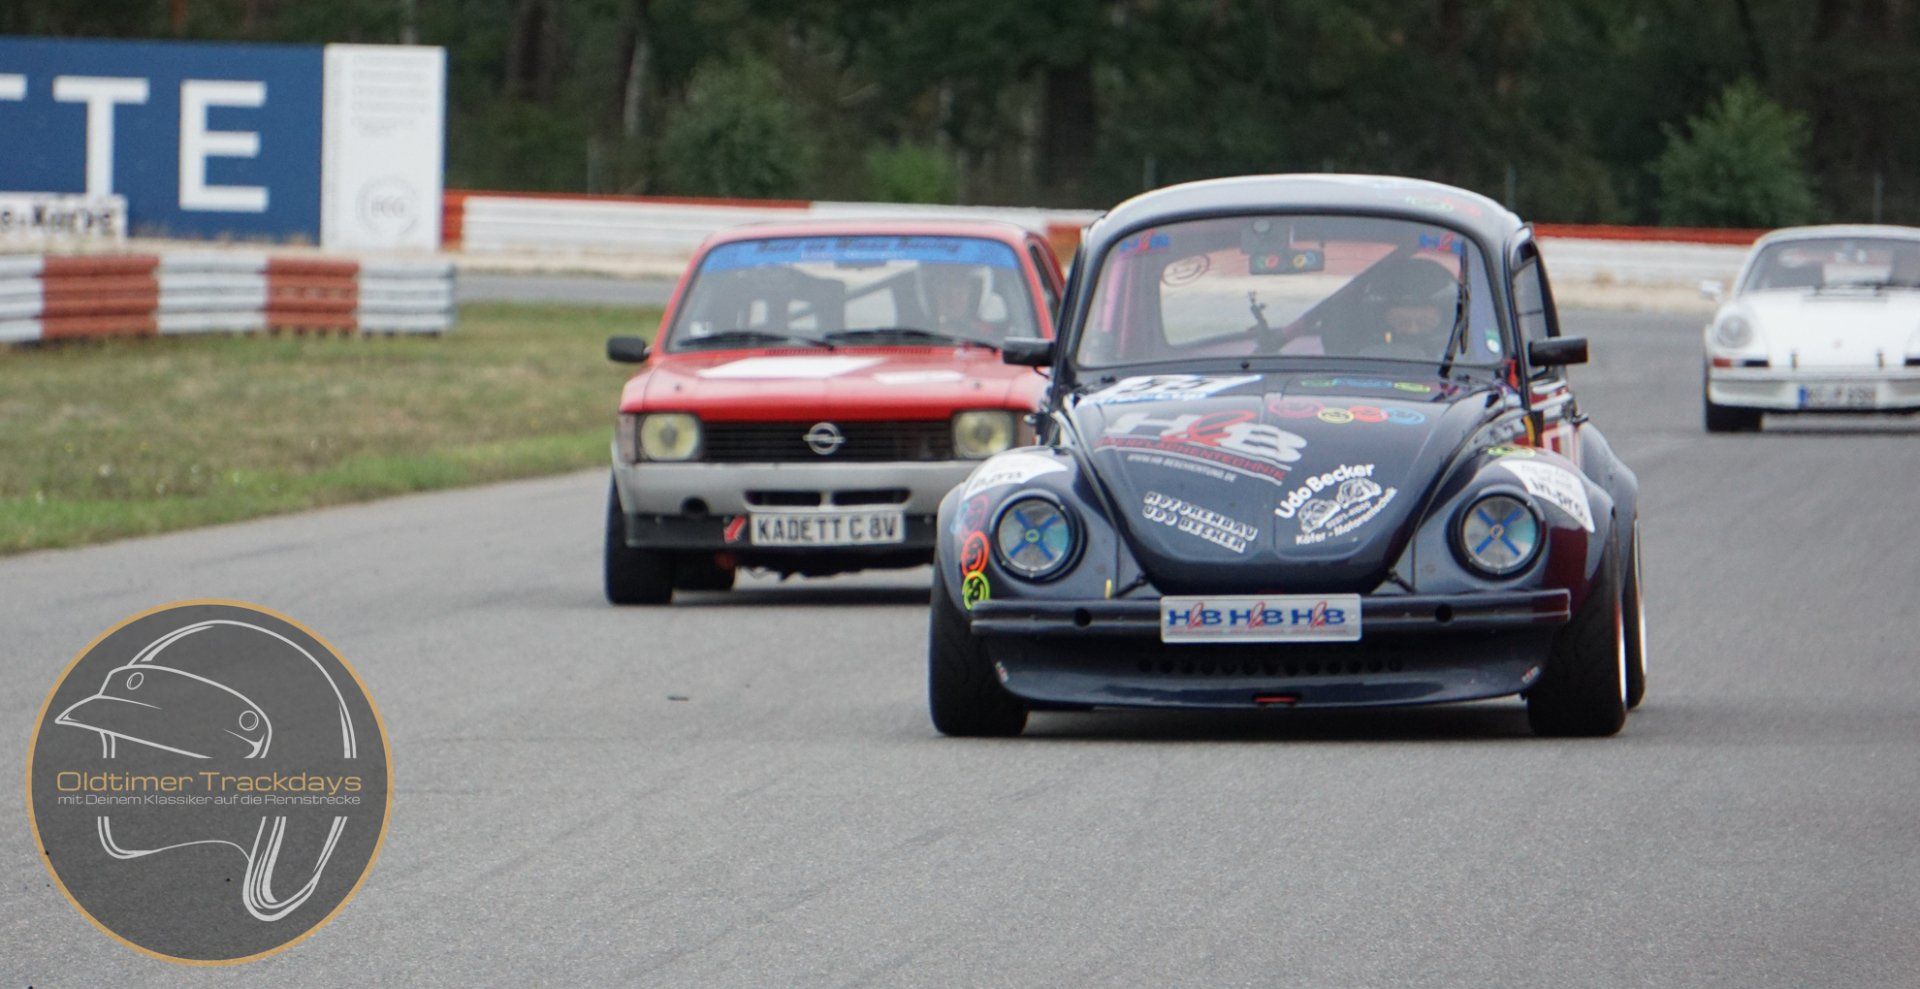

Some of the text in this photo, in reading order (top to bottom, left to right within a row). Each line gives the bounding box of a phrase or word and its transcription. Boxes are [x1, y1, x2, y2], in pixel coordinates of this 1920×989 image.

[1274, 486, 1312, 518] Udo
[1305, 464, 1375, 492] Becker
[757, 515, 897, 542] KADETT C 8V
